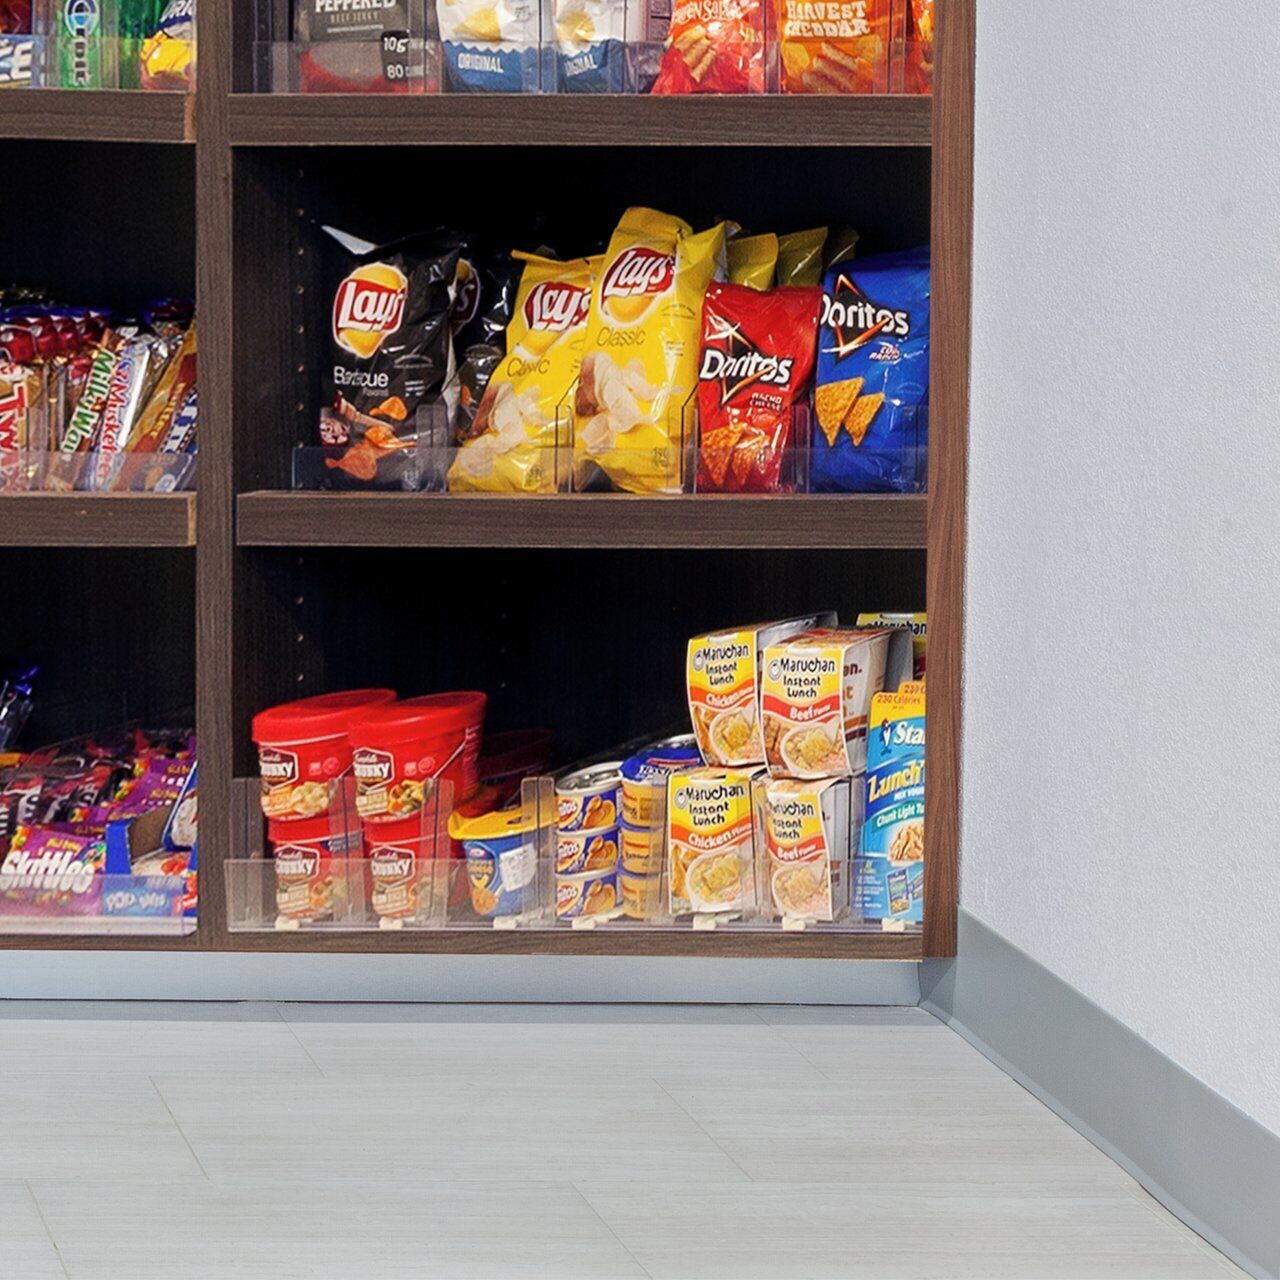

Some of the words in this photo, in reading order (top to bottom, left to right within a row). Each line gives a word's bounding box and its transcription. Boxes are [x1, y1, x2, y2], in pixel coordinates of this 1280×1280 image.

[785, 0, 867, 20] HARVEST
[784, 19, 870, 37] CHEDDAR
[604, 249, 675, 297] Lay's
[337, 281, 404, 332] Lay's
[596, 326, 647, 347] Classic
[699, 348, 792, 384] Doritos
[702, 643, 750, 662] Maruchan
[705, 662, 738, 676] Instant
[780, 658, 836, 673] Maruchan
[709, 674, 735, 686] Lunch
[783, 675, 821, 688] Instant
[705, 690, 738, 706] Chicken
[786, 687, 818, 699] Lunch
[877, 694, 893, 705] 230
[789, 706, 813, 720] Beef
[685, 783, 746, 802] Maruchan
[689, 801, 730, 816] Instant
[773, 800, 815, 816] ruchan
[692, 814, 726, 826] Lunch
[688, 830, 731, 847] Chicken
[776, 846, 798, 861] Beef
